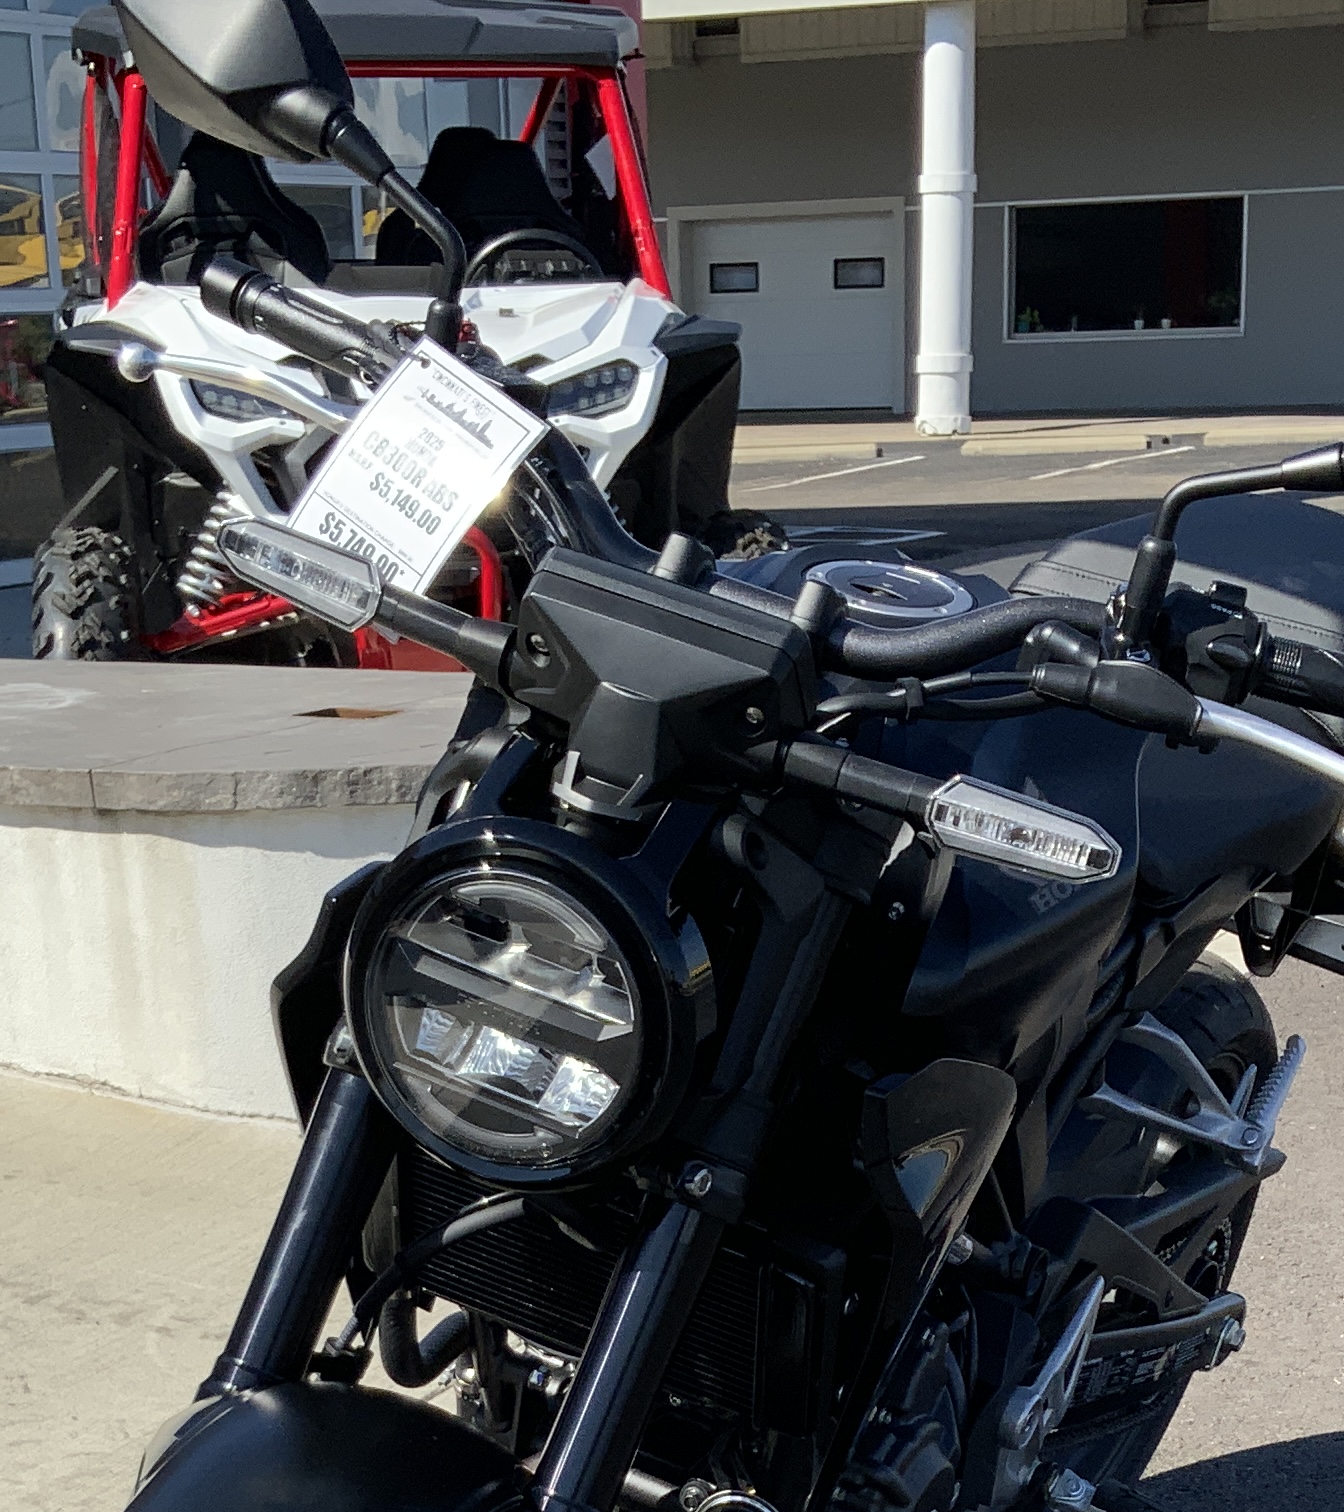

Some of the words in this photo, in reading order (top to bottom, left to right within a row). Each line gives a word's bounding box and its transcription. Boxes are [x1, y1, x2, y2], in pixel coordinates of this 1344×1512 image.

[363, 430, 428, 489] CB300R
[421, 478, 459, 512] ABS
[417, 427, 445, 452] 2025
[369, 472, 441, 536] $5,149.00
